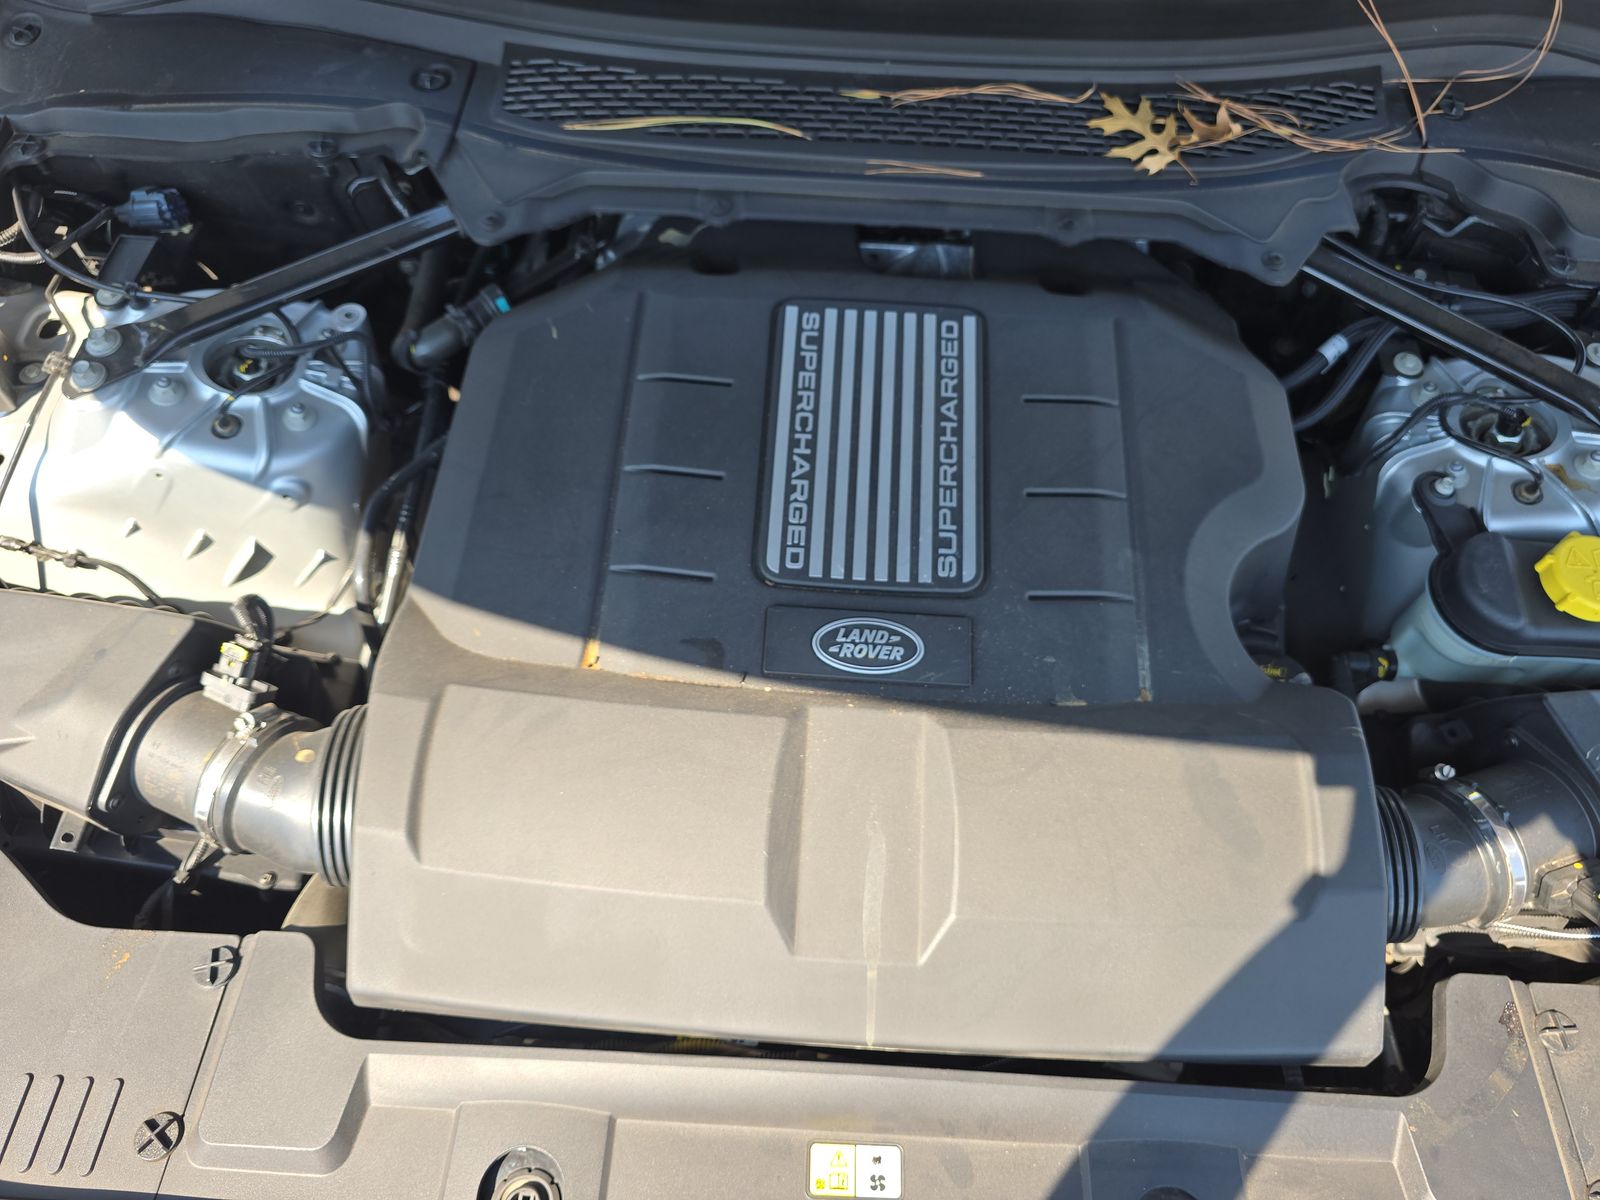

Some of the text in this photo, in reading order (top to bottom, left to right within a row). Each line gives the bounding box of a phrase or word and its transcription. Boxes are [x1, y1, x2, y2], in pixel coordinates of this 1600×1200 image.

[785, 311, 820, 570] SUPERCHARGED
[937, 319, 959, 579] SUPERCHARGED
[836, 627, 889, 644] LAND
[839, 643, 905, 661] ROVER
